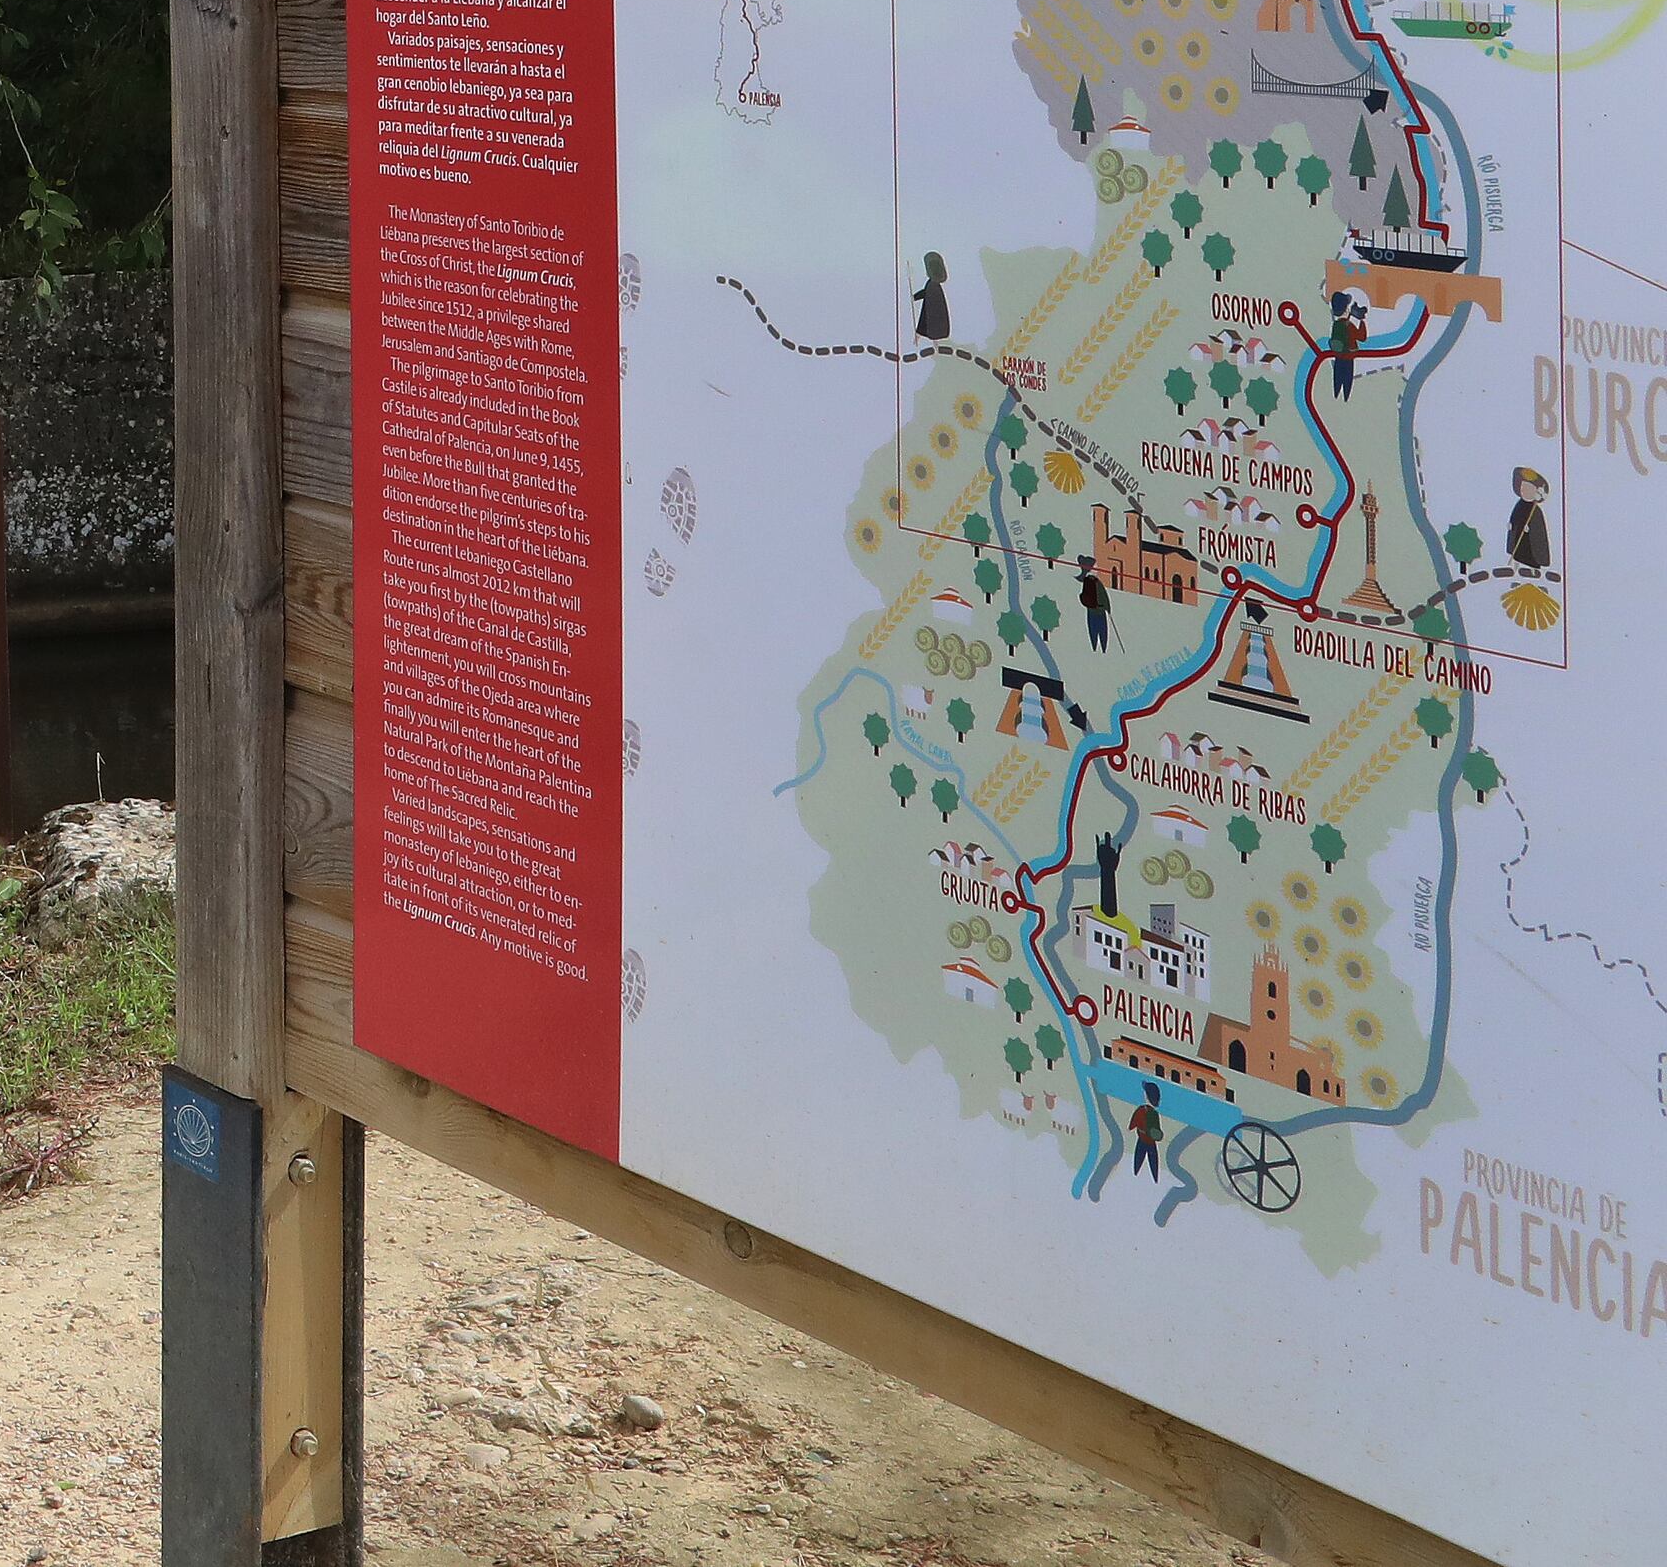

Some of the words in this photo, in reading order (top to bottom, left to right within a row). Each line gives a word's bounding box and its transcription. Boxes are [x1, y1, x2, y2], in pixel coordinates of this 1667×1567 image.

[748, 92, 782, 107] PALENCIA
[388, 205, 407, 221] The
[409, 208, 465, 230] Monastery
[467, 214, 478, 229] of
[480, 216, 510, 233] Santo
[512, 220, 548, 239] Toribio
[550, 225, 564, 241] de
[1211, 292, 1273, 327] OSORNO
[1037, 361, 1046, 376] DE
[1088, 444, 1102, 460] DE
[1140, 442, 1214, 481] REQUENA
[1220, 454, 1240, 485] DE
[1248, 458, 1314, 497] CAMPOS
[1198, 526, 1277, 570] FRÓMISTA
[1293, 625, 1376, 670] BOADILLA
[1384, 645, 1415, 679] DEL
[1423, 652, 1492, 696] CAMINO
[1130, 753, 1225, 808] CALAHORRA
[1231, 778, 1251, 812] DE
[1258, 787, 1307, 826] RIBAS
[941, 870, 999, 912] GRIJOTA
[1102, 984, 1195, 1045] PALENCIA
[1463, 1148, 1586, 1226] PROVINCIA
[1598, 1193, 1627, 1240] DE
